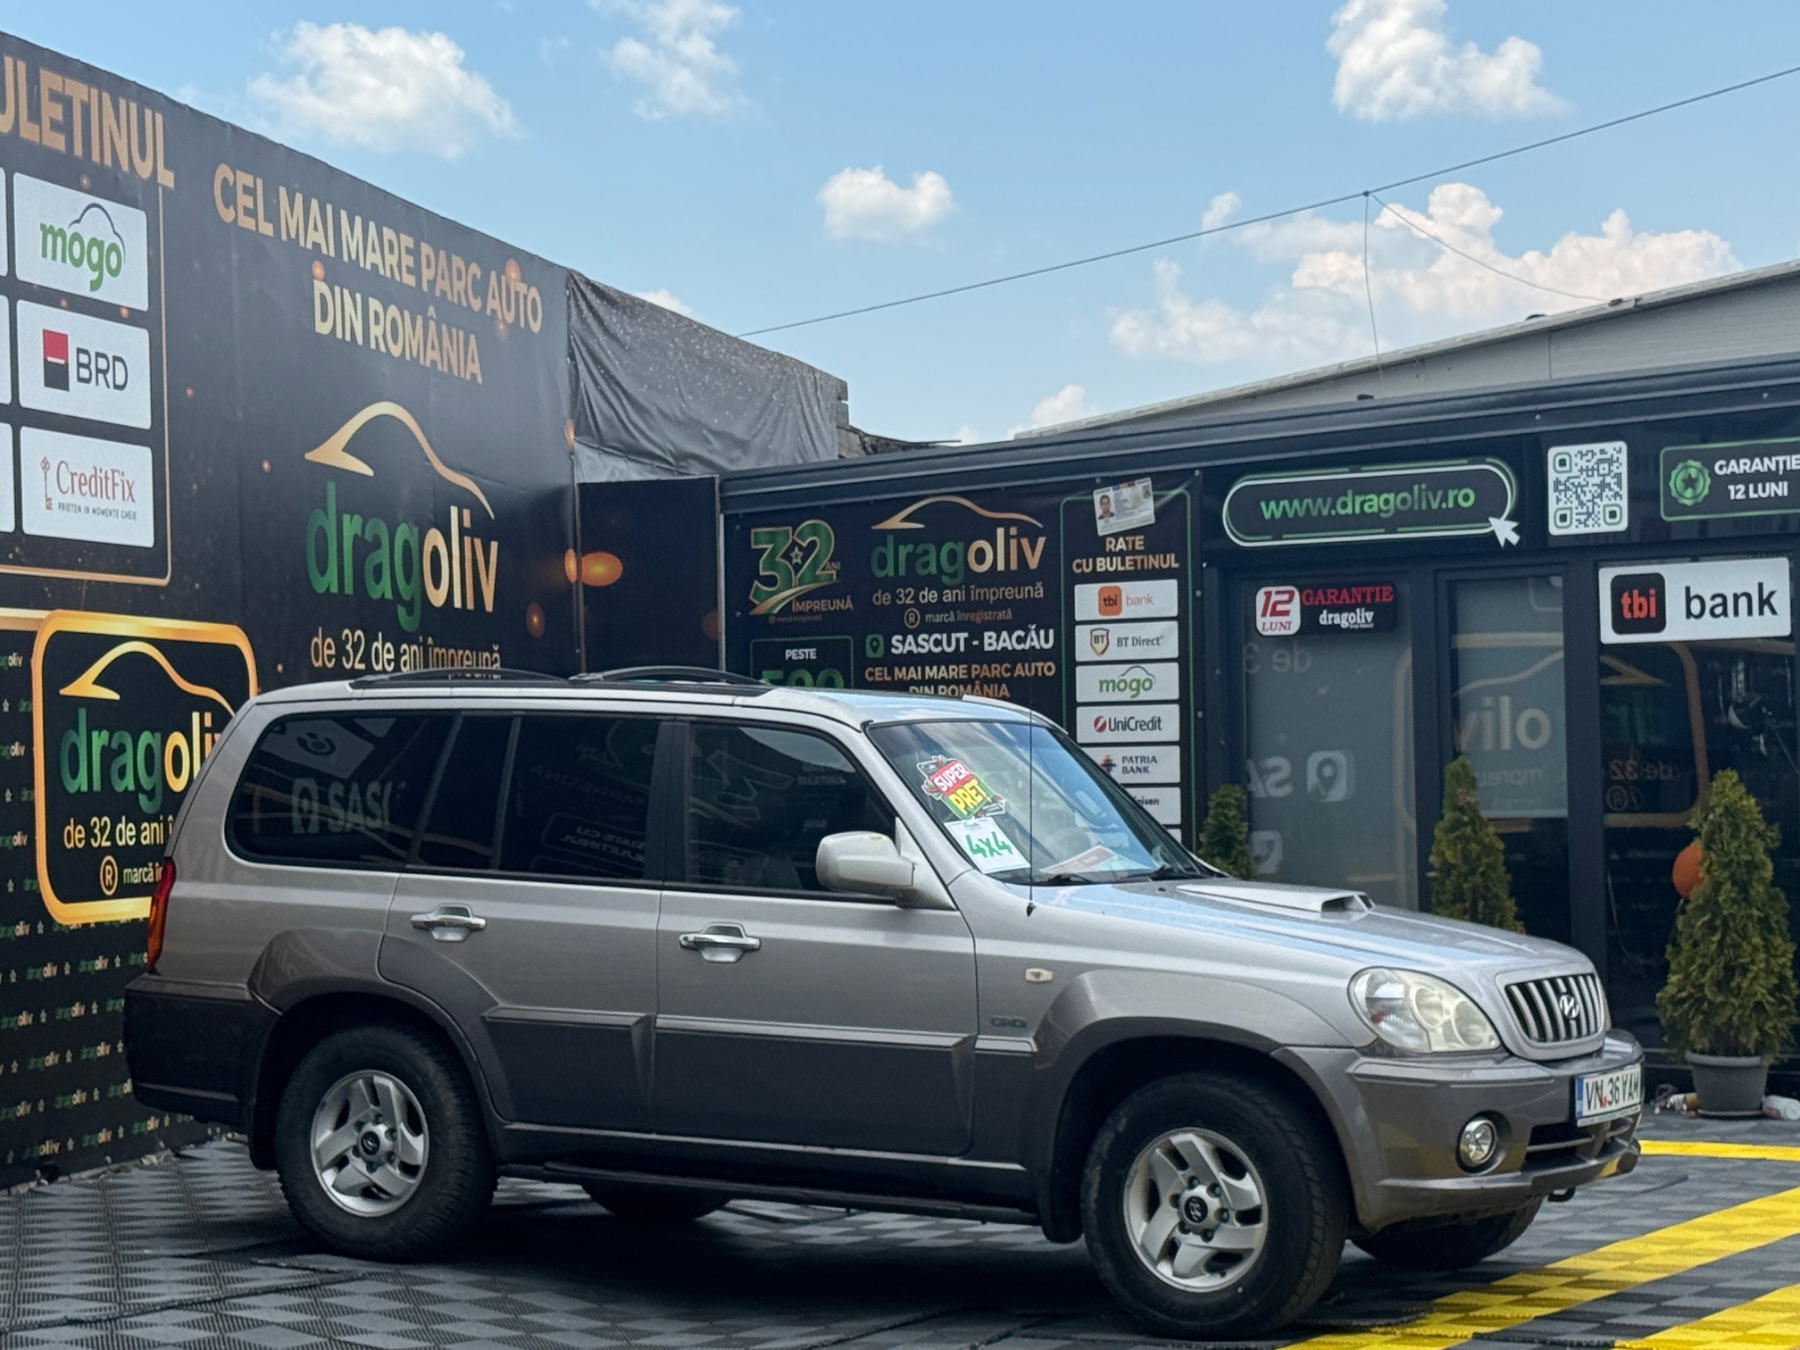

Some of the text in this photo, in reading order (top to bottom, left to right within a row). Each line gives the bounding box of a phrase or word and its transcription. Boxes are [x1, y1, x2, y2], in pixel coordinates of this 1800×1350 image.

[40, 222, 122, 292] mogo
[214, 164, 544, 334] CEL MAI MARE PARC AUTO
[313, 279, 483, 385] DIN ROMÂNIA
[76, 347, 128, 391] BRD
[56, 460, 136, 503] CreditFix
[1728, 481, 1788, 500] 12 LUNI
[1260, 483, 1476, 520] www.dragoliv.ro
[306, 480, 499, 632] dragoliv
[870, 526, 1046, 585] dragoliv
[1105, 535, 1146, 552] RATE
[750, 519, 835, 606] 32
[1072, 553, 1180, 573] CU BULETINUL
[872, 582, 1044, 605] de 32 de ani împreună
[1103, 594, 1154, 607] tbi bank
[1261, 589, 1295, 618] 12
[1302, 586, 1394, 606] GARANTIE
[1621, 582, 1778, 620] tbi bank
[1261, 621, 1292, 632] LUNI
[1319, 608, 1375, 629] dragoliv
[310, 627, 336, 668] de
[341, 629, 366, 670] 32
[371, 631, 395, 672] de
[400, 635, 424, 673] ani
[785, 648, 817, 660] PESTE
[891, 632, 969, 655] SASCUT
[983, 624, 1055, 651] BACĂU
[1116, 637, 1130, 647] BT
[864, 661, 1056, 681] CEL MAI MARE PARC AUTO
[1098, 678, 1154, 698] mogo
[1108, 715, 1163, 732] UniCredit
[60, 707, 221, 814] dragoli
[1122, 755, 1158, 765] PATRIA
[1122, 766, 1150, 774] BANK
[933, 762, 970, 792] SUPER
[64, 817, 86, 849] de
[90, 816, 112, 848] 32
[115, 815, 136, 846] de
[140, 815, 164, 845] ani
[123, 862, 154, 884] marcă
[1586, 1080, 1604, 1111] VN
[1607, 1076, 1620, 1106] 36
